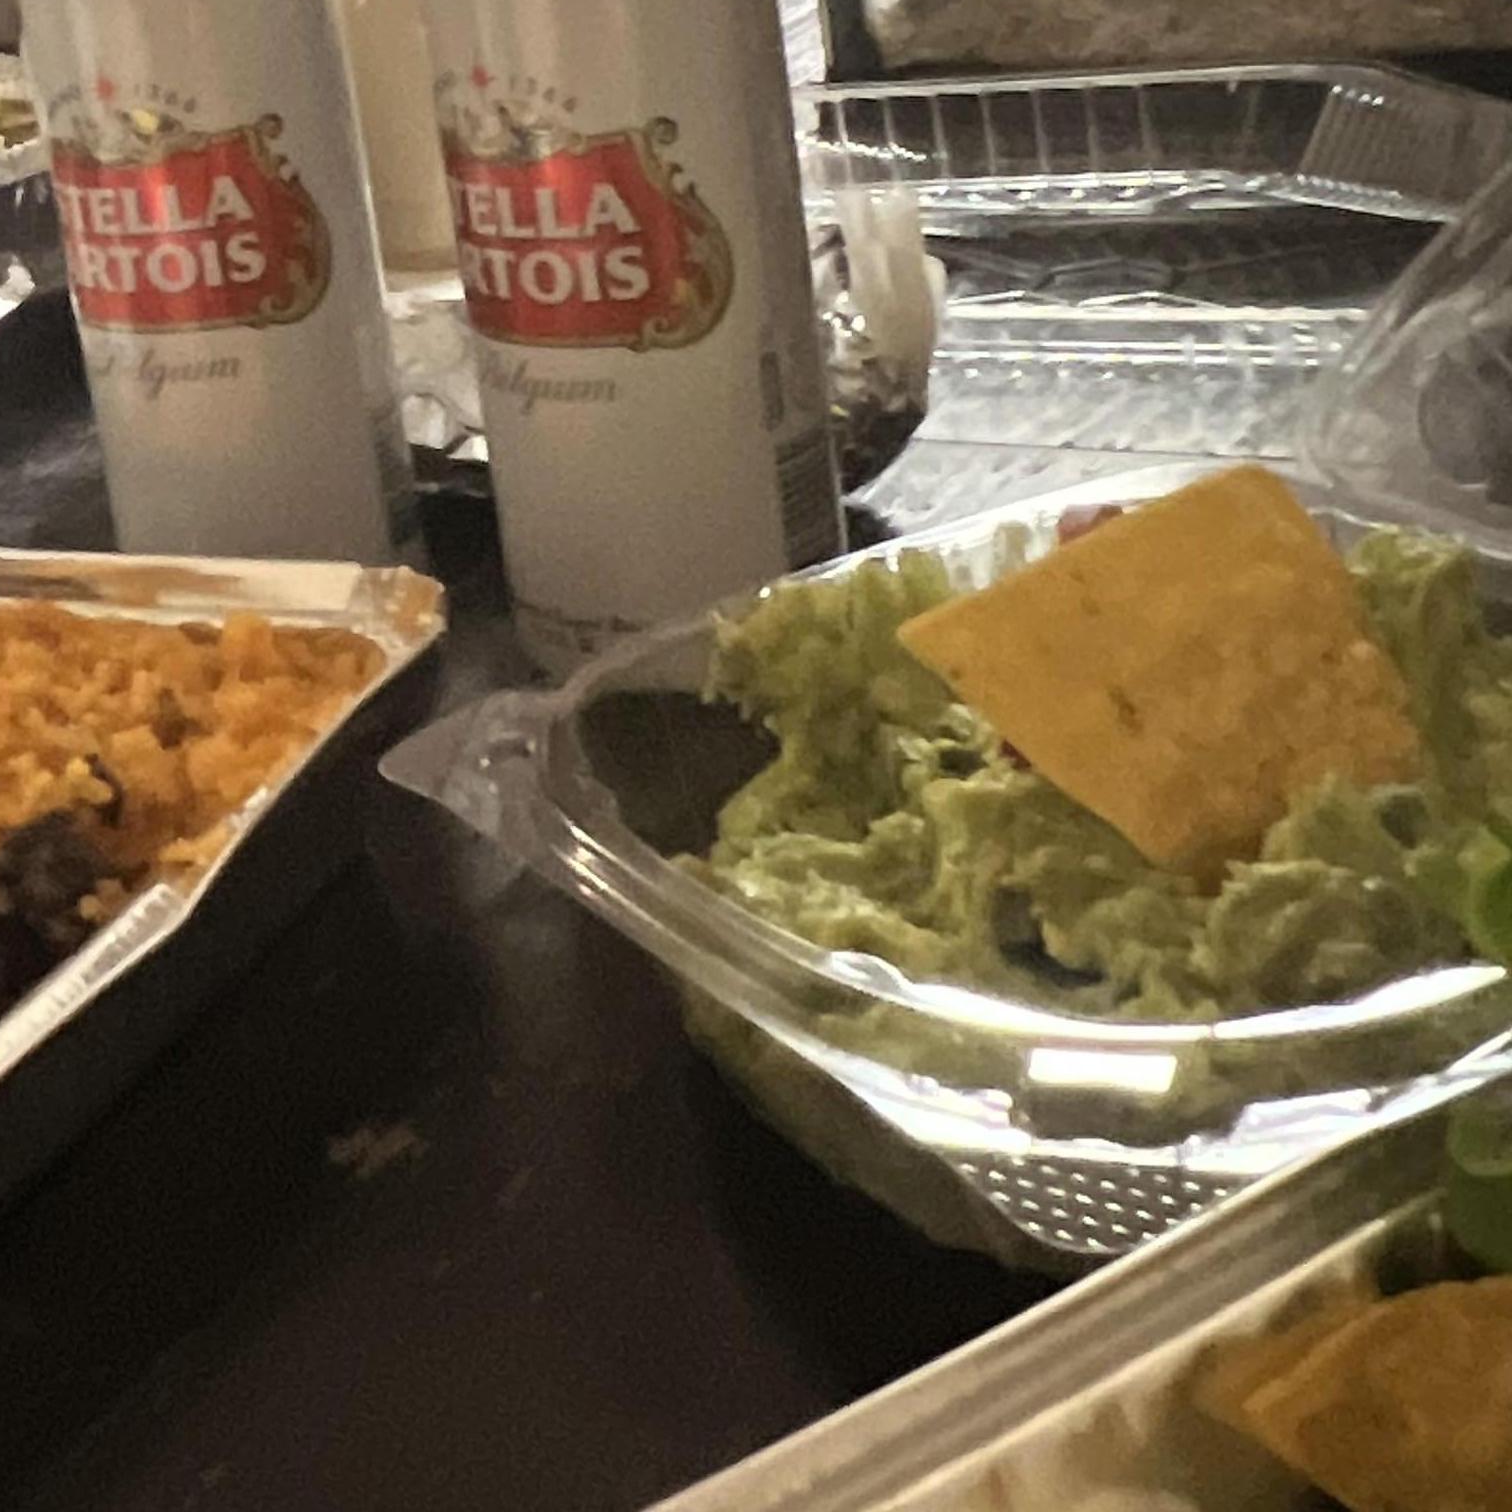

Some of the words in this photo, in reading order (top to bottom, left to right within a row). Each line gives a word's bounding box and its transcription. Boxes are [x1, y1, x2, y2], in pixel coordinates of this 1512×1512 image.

[51, 174, 255, 235] TELLA
[65, 231, 267, 294] RTOIS
[458, 245, 651, 306] RTOIS
